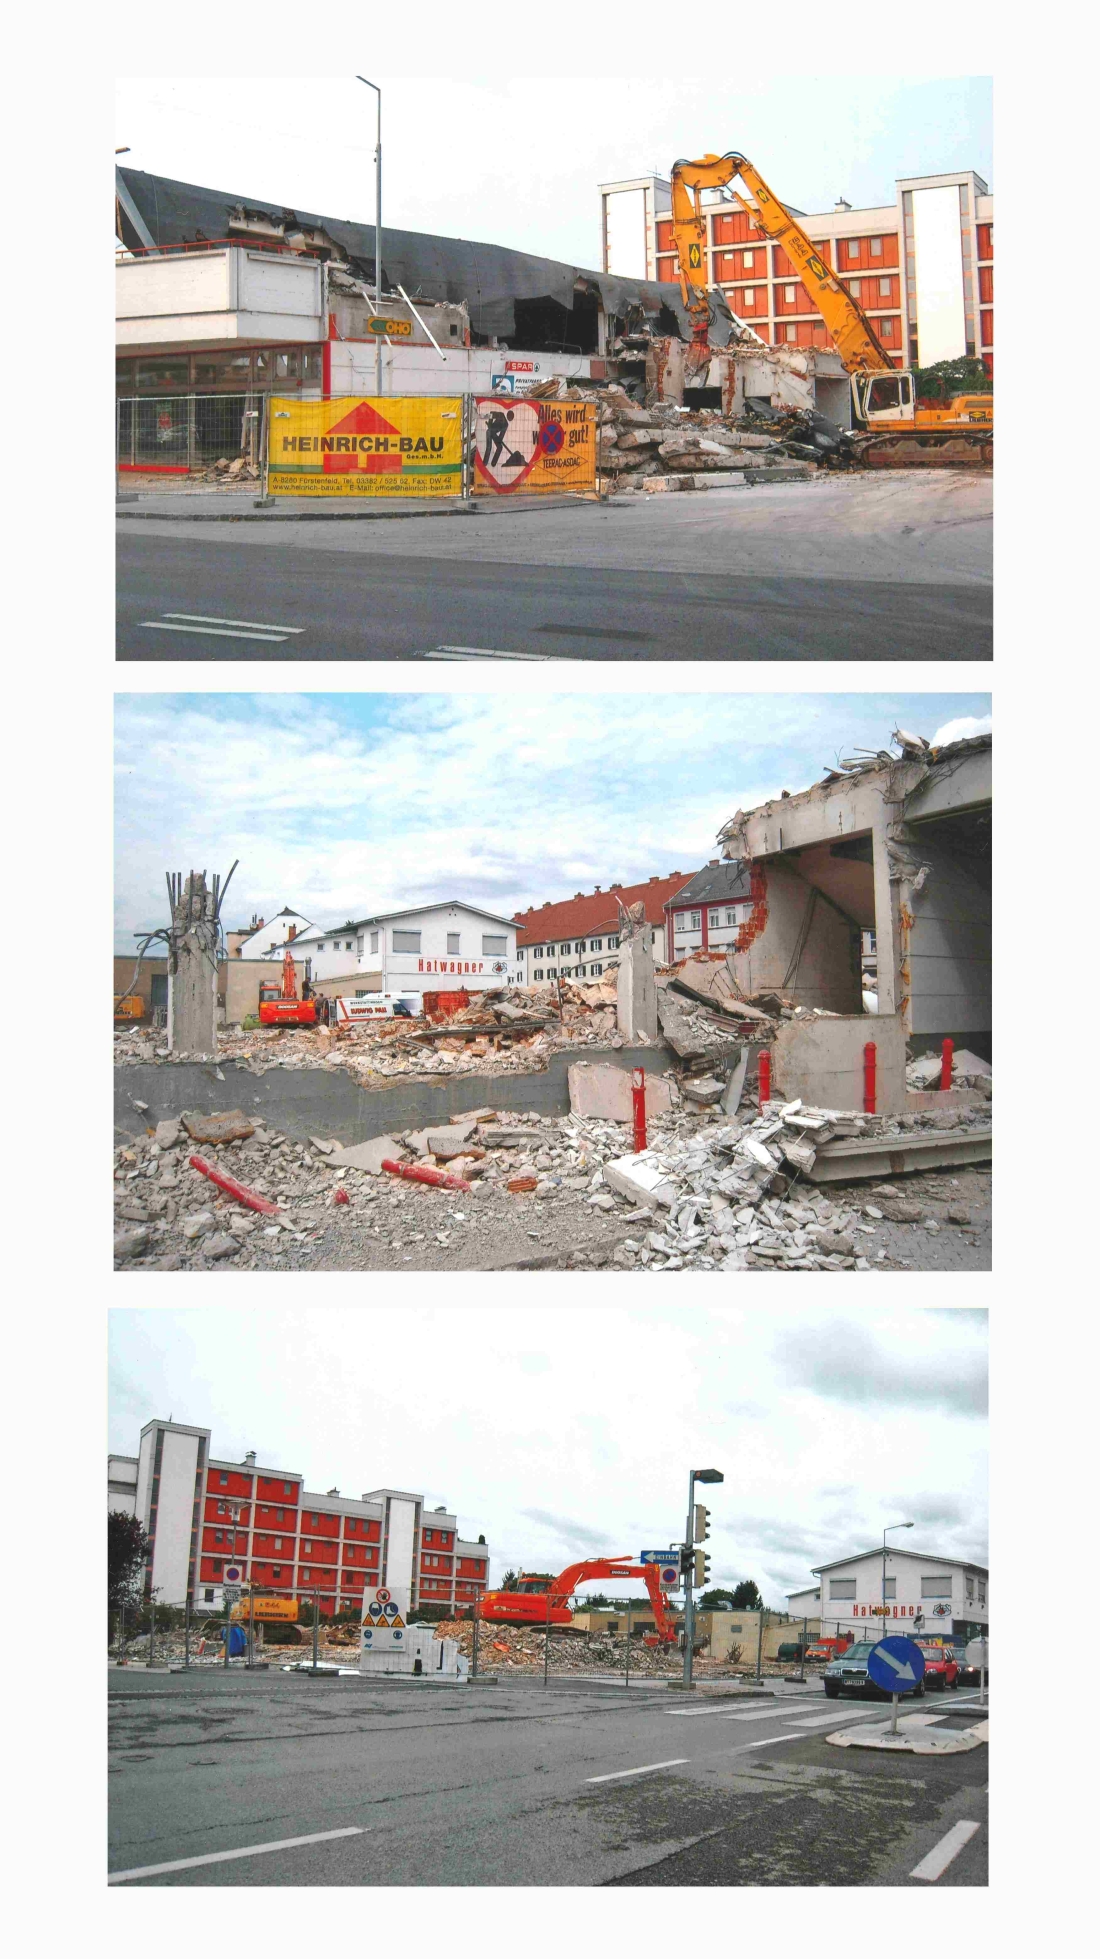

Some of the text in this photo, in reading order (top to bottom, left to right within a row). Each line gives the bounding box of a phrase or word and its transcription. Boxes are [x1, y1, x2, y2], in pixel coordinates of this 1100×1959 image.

[386, 321, 410, 335] OHO
[511, 362, 533, 371] SPAR
[537, 404, 587, 424] Alles wird
[568, 424, 590, 448] gut!
[283, 437, 444, 452] HEINRICH-BAU
[543, 457, 581, 469] TEERAG-ASDAG
[418, 958, 484, 974] Hatwagner
